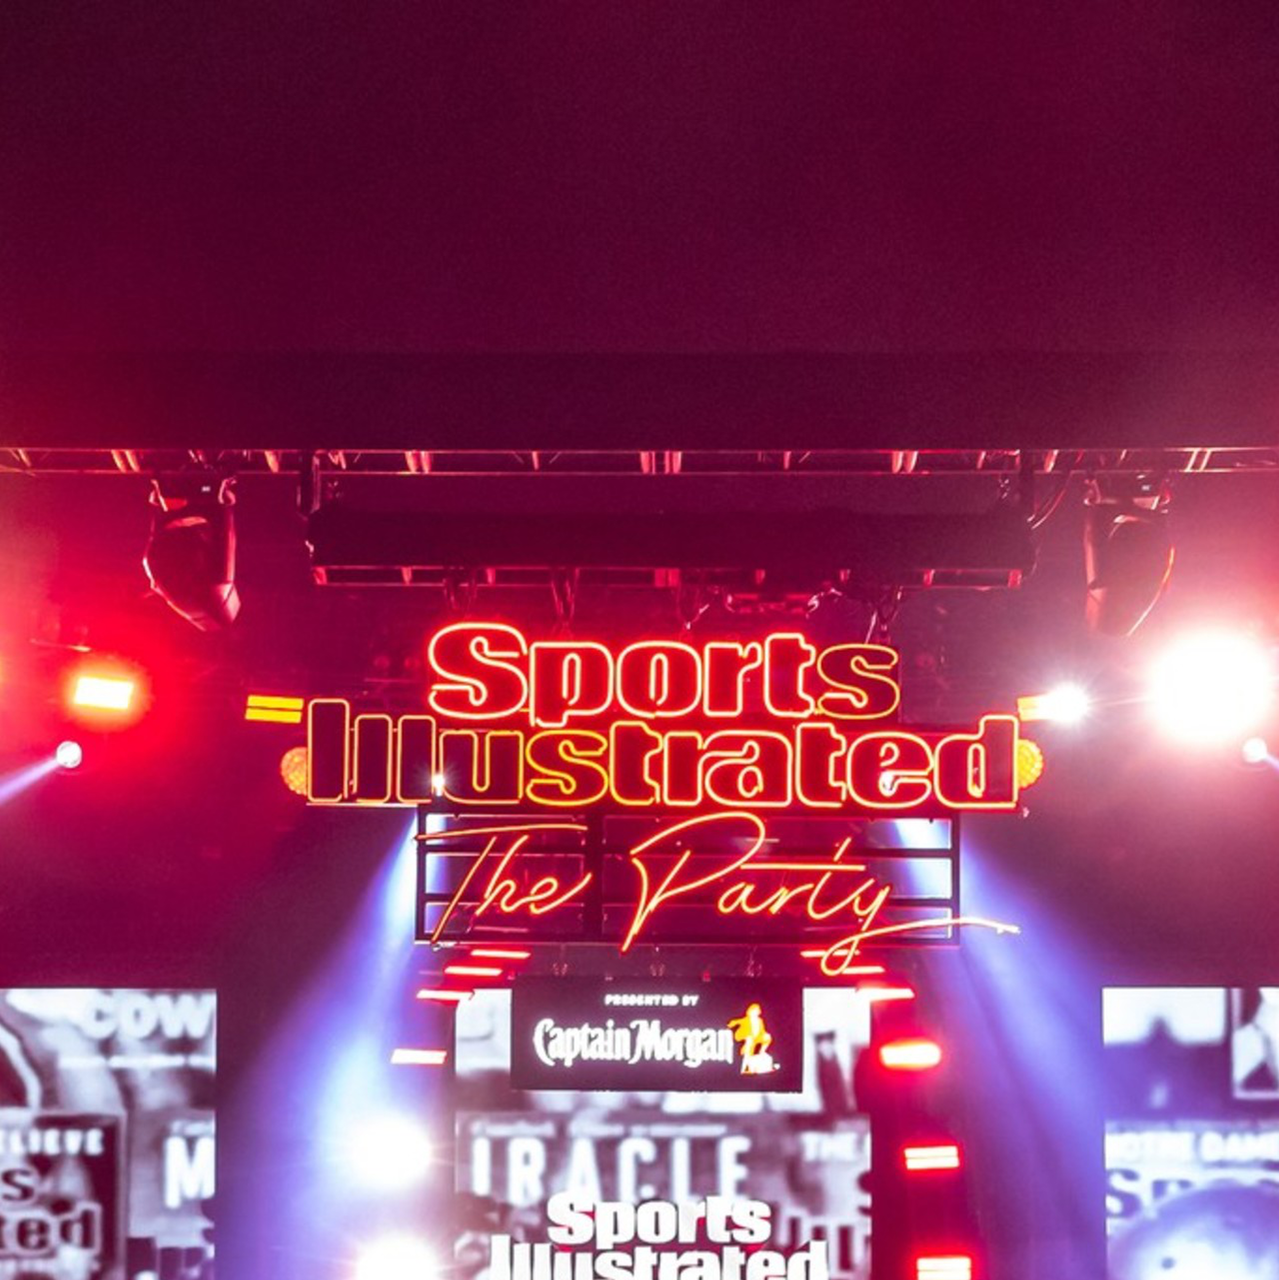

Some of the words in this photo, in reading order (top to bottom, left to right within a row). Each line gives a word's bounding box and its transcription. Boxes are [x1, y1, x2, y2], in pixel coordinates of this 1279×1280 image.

[426, 621, 903, 728] Sports
[306, 697, 1021, 808] Illustrated
[414, 821, 592, 949] The
[621, 811, 1021, 976] Party
[604, 994, 679, 1007] PRESENTED
[682, 994, 699, 1006] BY
[532, 1018, 630, 1067] Captain
[630, 1018, 734, 1069] Morgan
[546, 1193, 772, 1248] Sports
